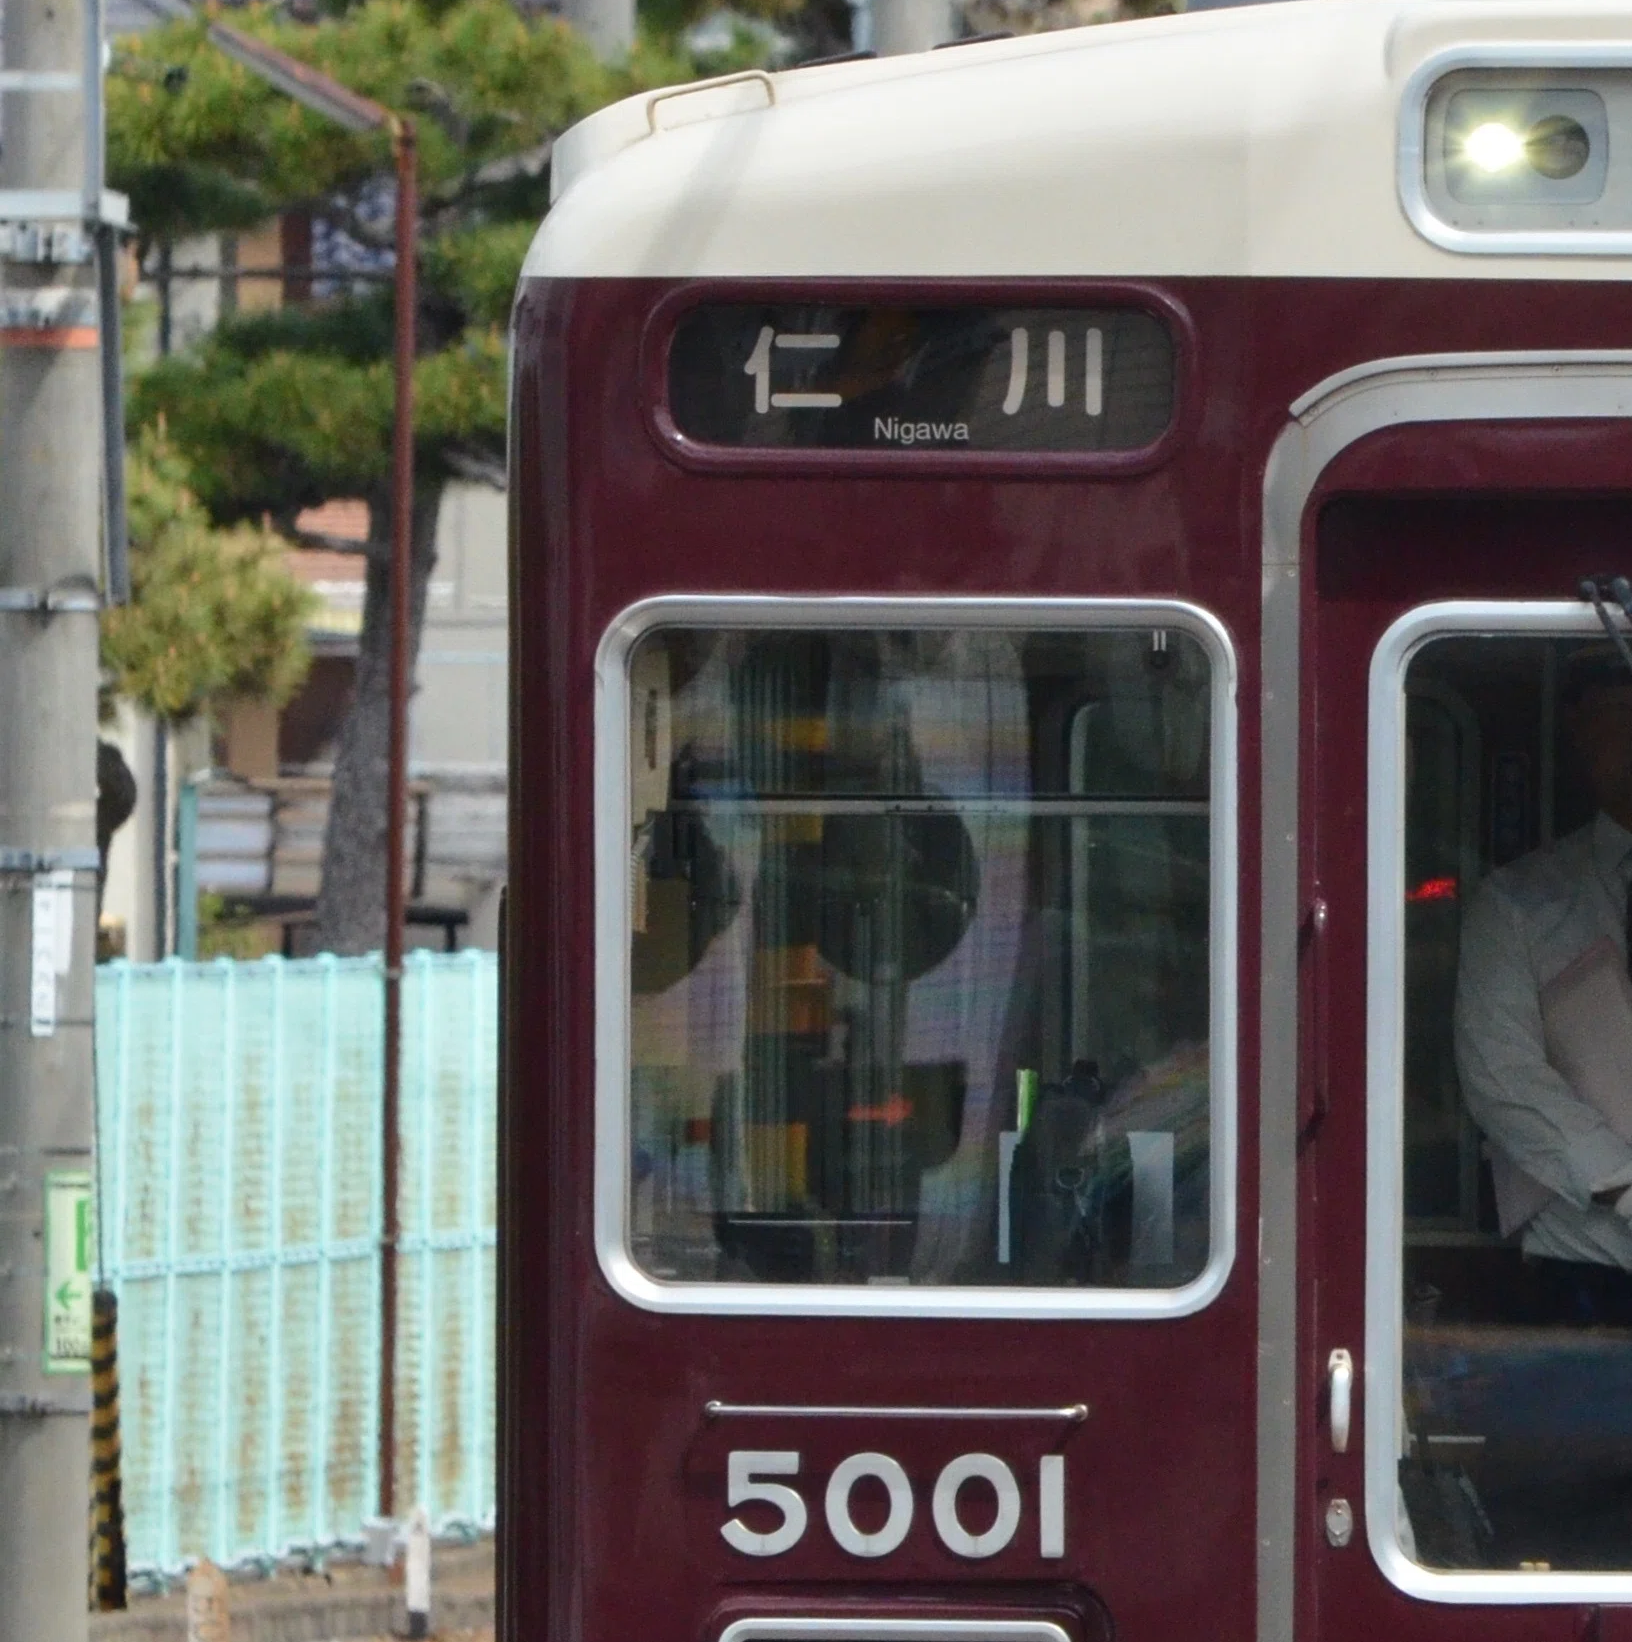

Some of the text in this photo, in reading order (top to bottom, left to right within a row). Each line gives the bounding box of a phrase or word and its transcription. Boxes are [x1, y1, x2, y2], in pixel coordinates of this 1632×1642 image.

[744, 325, 1102, 416] 仁川
[873, 417, 969, 444] Nigawa
[720, 1450, 1065, 1559] 5001
